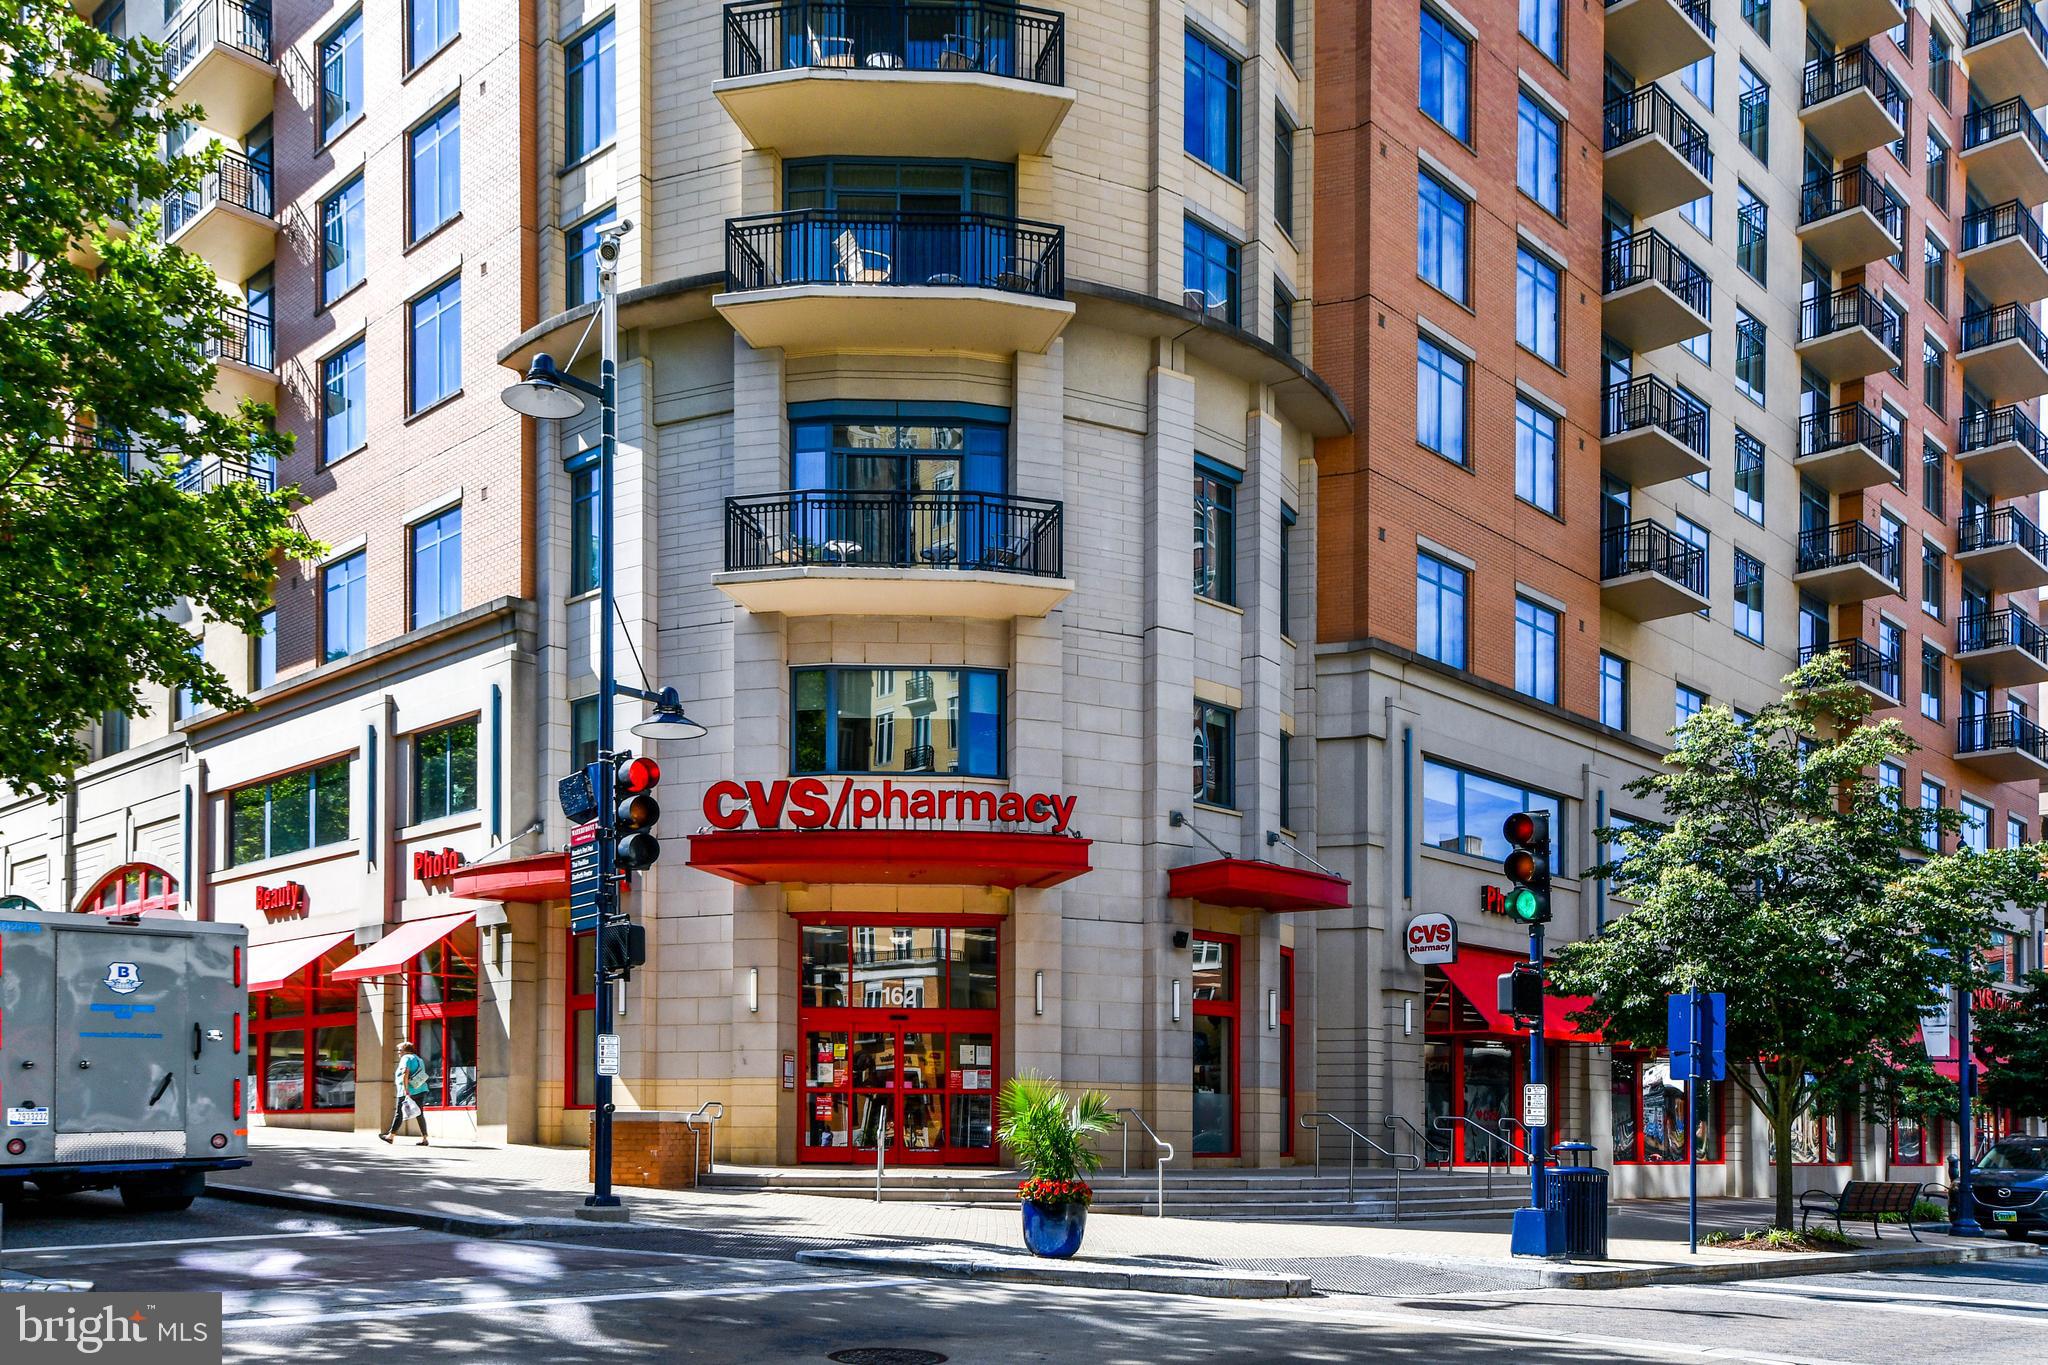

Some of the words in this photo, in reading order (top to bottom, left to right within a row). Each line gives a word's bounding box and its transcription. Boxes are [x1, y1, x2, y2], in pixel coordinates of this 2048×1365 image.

[703, 777, 1077, 833] CVS/pharmacy
[413, 847, 459, 881] Photo
[256, 881, 298, 911] Beauty
[1408, 923, 1451, 945] CVS
[1409, 943, 1450, 955] pharmacy
[118, 966, 129, 977] B
[882, 986, 916, 1006] 162
